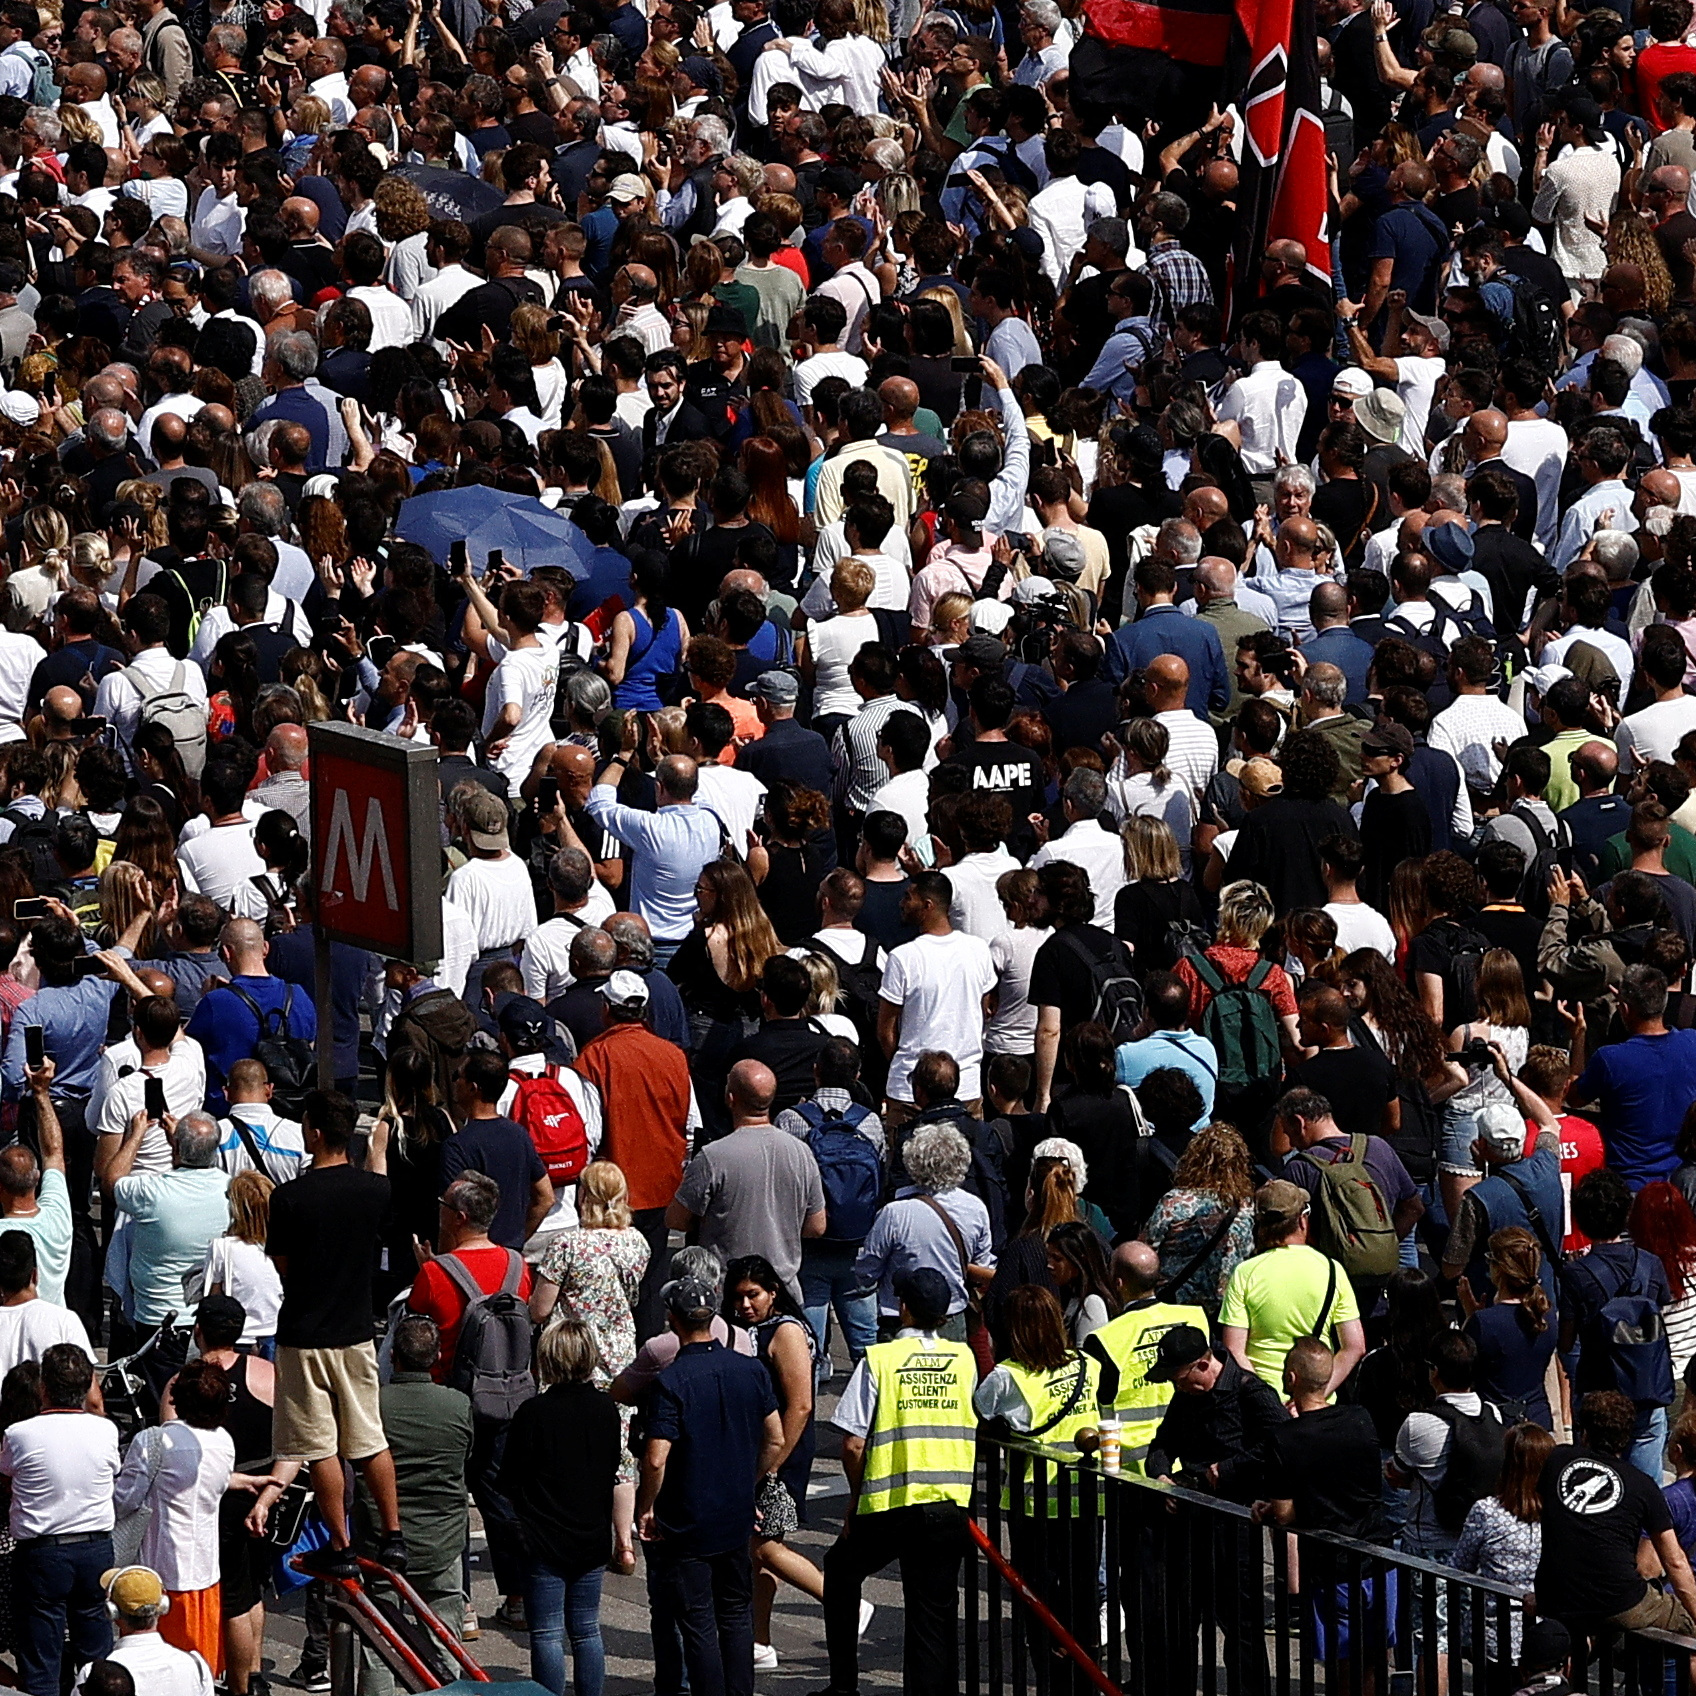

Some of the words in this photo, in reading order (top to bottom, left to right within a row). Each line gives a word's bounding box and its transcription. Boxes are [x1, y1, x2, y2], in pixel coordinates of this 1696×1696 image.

[973, 763, 1032, 789] AAPE
[322, 788, 400, 911] M
[915, 1357, 940, 1368] ATM
[899, 1373, 958, 1385] ASSISTENZA
[912, 1385, 948, 1397] CLIENTI
[897, 1399, 939, 1411] CUSTOMER
[941, 1398, 958, 1409] CARE
